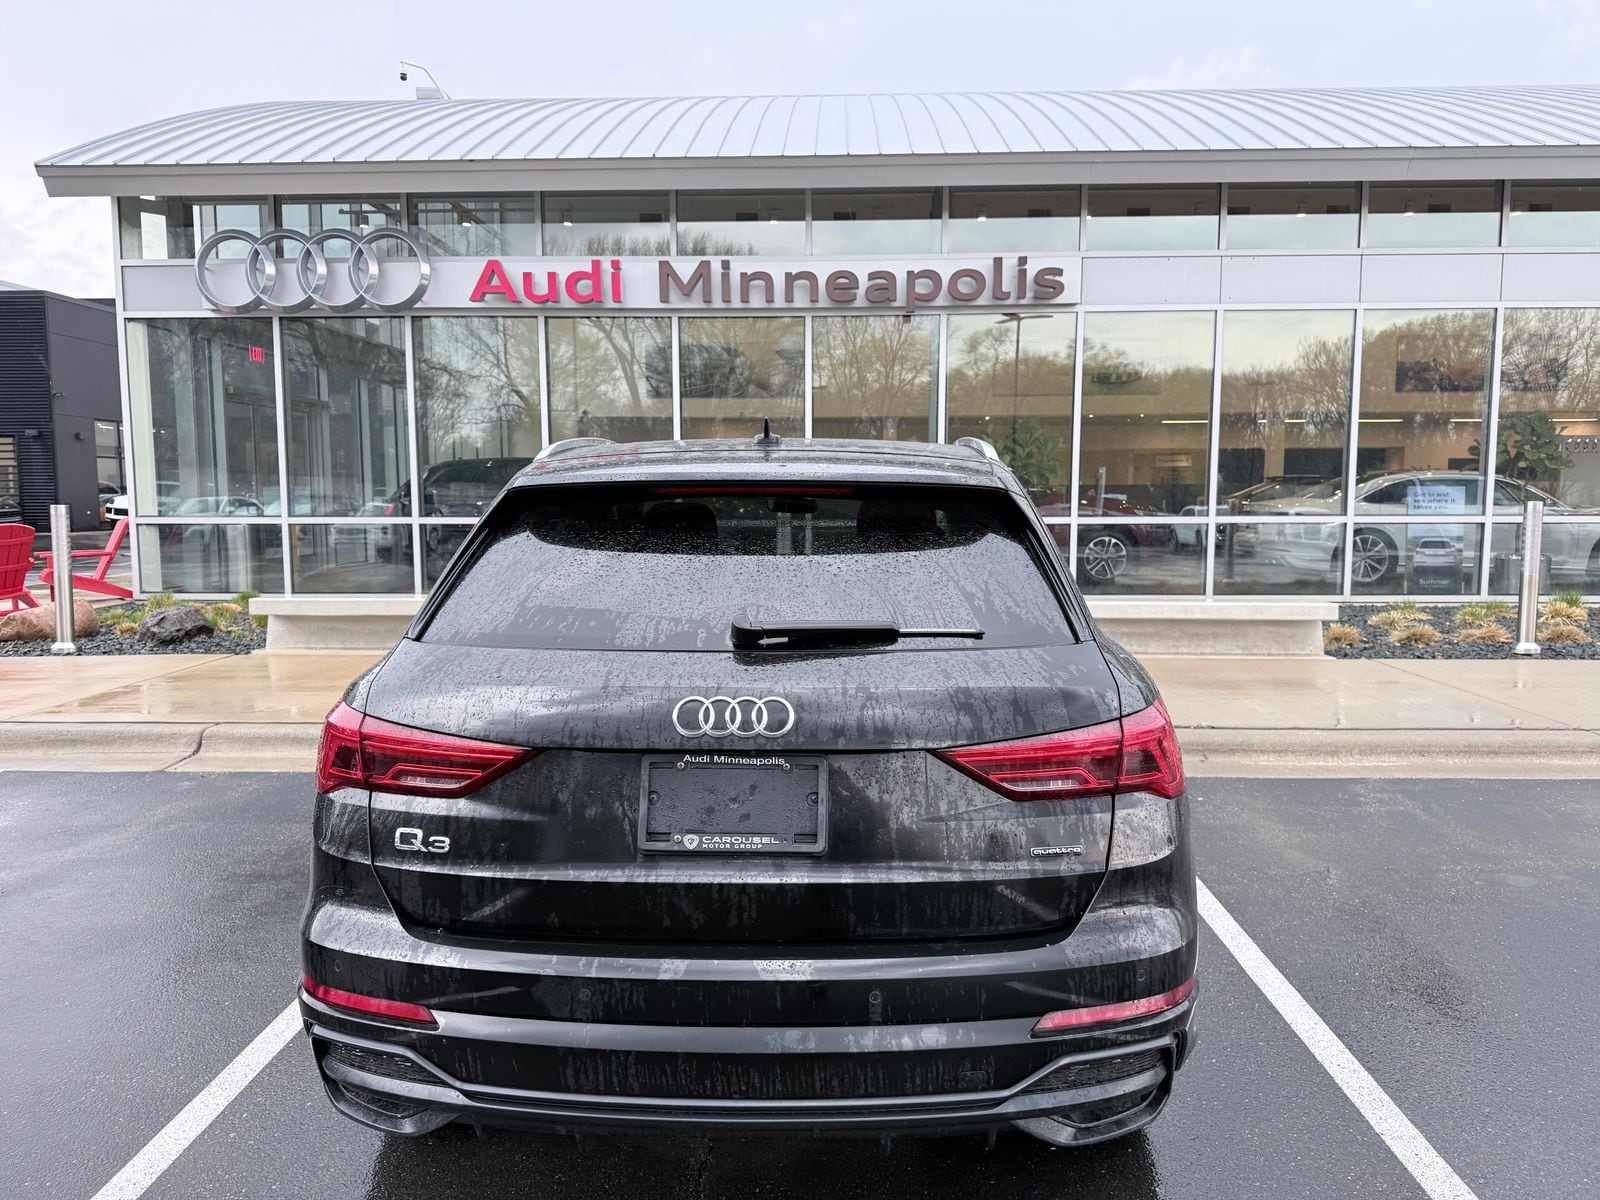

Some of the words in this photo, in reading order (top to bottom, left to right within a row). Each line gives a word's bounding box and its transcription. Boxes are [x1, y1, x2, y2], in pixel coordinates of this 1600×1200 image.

[469, 258, 623, 304] Audi
[658, 255, 1066, 312] Minneapolis
[1419, 577, 1449, 585] Summer
[683, 754, 710, 763] Audi
[713, 755, 786, 765] Minneapolis
[394, 827, 450, 854] Q3
[702, 836, 780, 844] CAROUSEL
[1033, 847, 1081, 855] quattro
